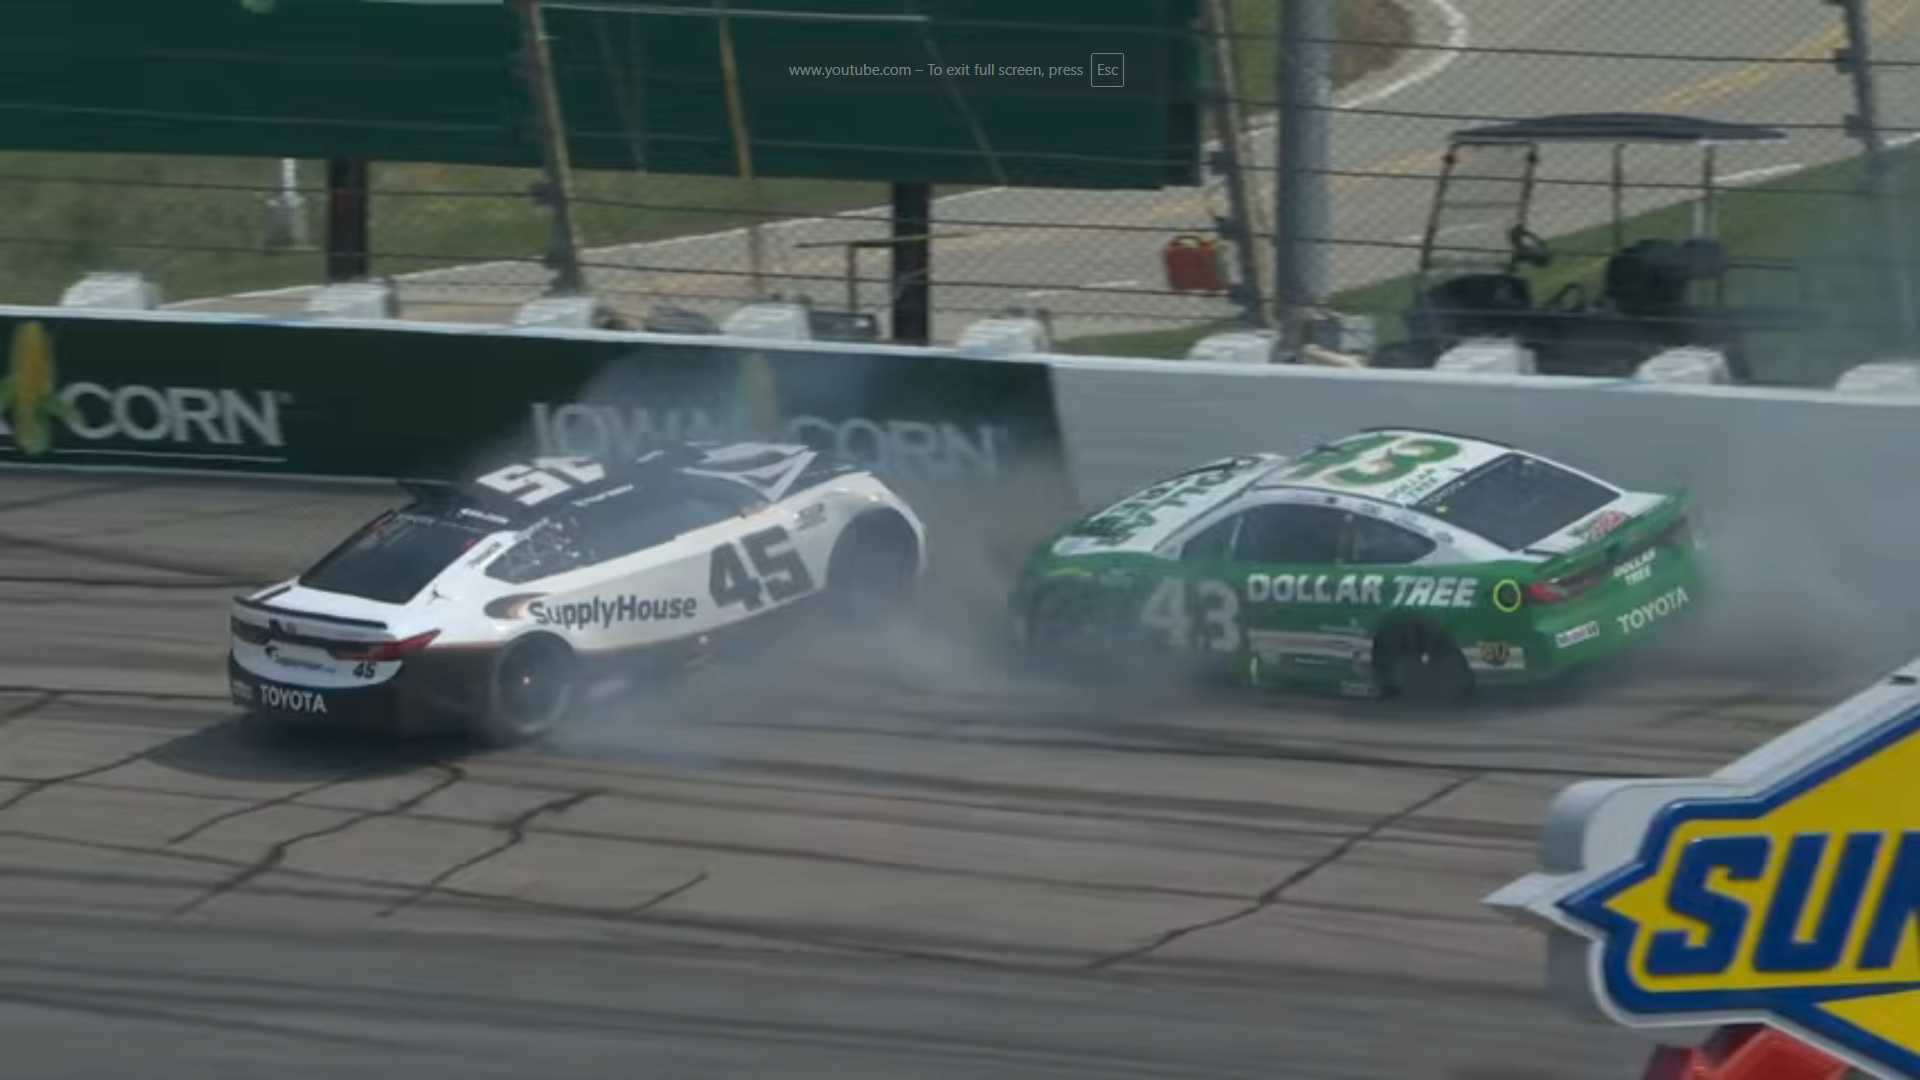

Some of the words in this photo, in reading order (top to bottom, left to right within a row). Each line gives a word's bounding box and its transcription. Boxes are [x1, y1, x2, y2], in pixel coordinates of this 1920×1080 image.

[60, 382, 286, 447] CORN
[709, 524, 815, 613] 45
[1247, 573, 1383, 603] DOLLAR
[1392, 575, 1479, 608] TREE
[1616, 586, 1690, 635] TOYOTA
[528, 594, 697, 630] SupplyHouse
[1142, 575, 1240, 653] 43
[353, 662, 377, 679] 45
[260, 685, 328, 715] TOYOTA
